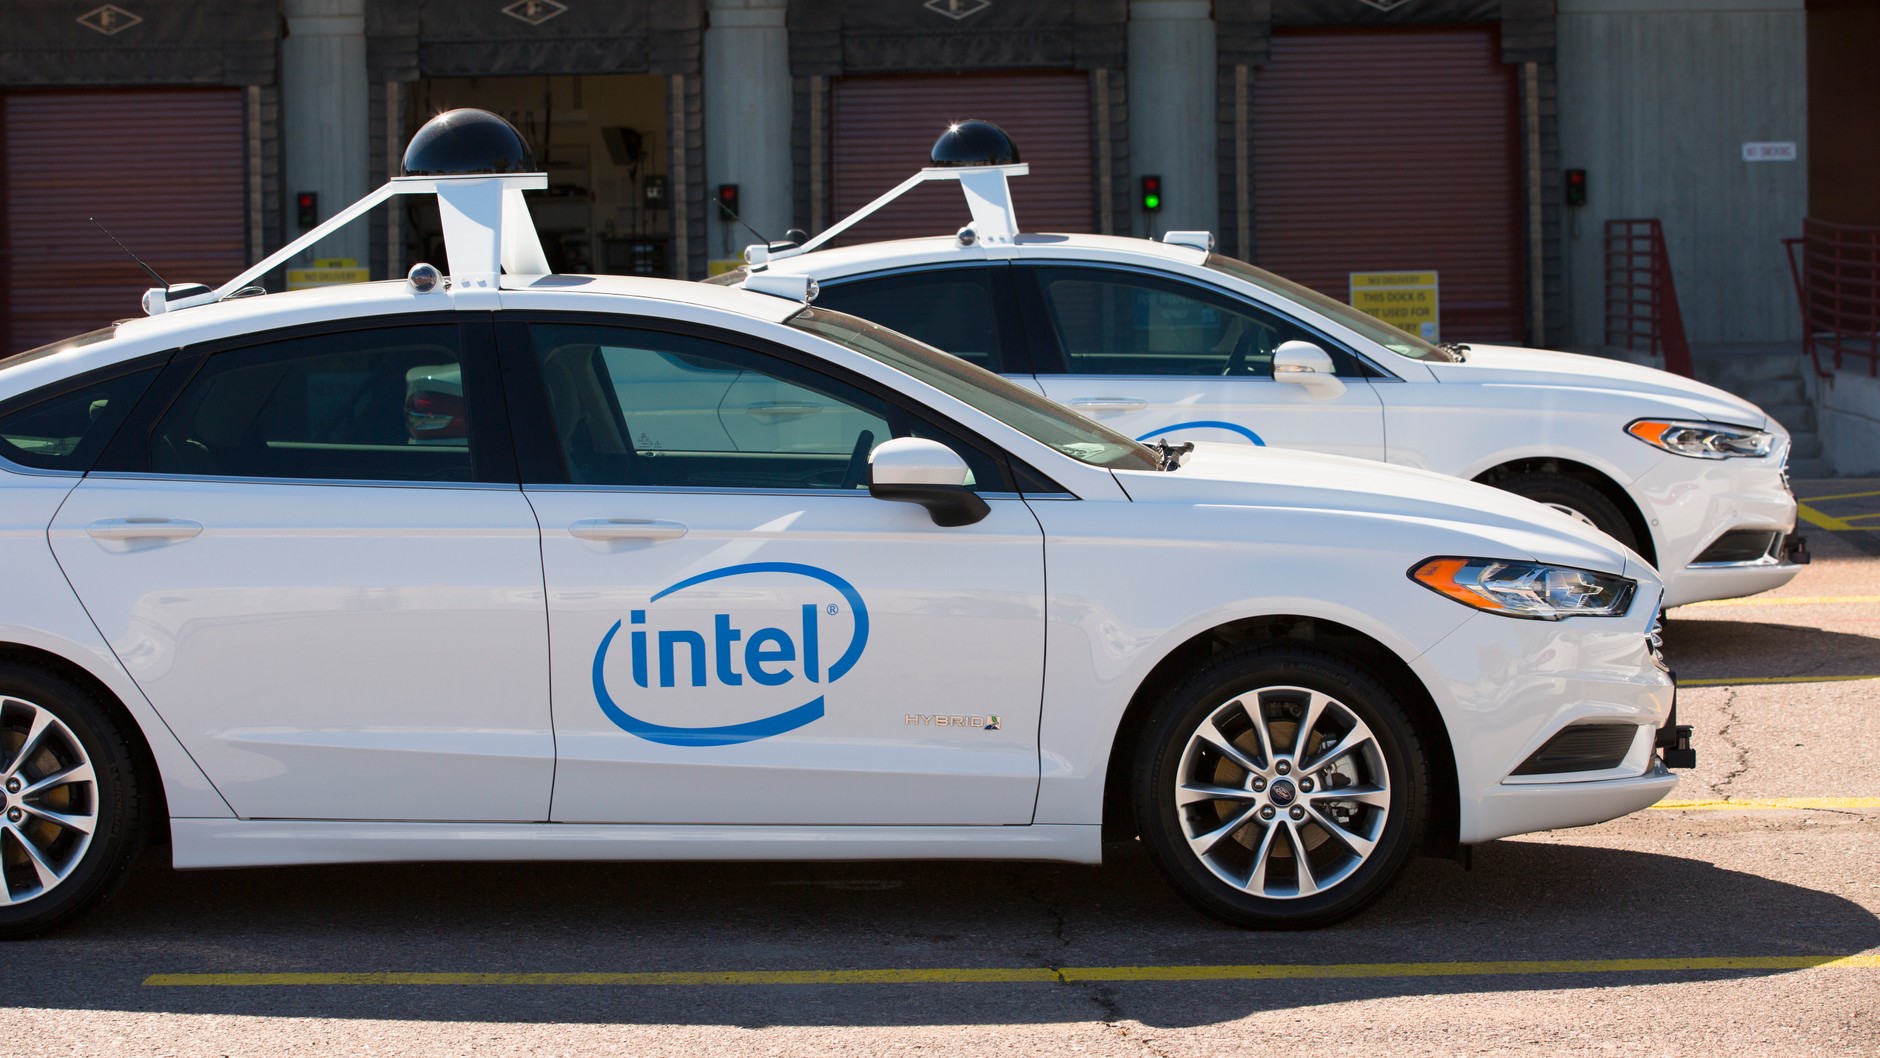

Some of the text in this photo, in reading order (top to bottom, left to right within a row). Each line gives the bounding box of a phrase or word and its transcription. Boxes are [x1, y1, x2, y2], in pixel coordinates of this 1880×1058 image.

[1747, 146, 1757, 157] NO
[304, 272, 357, 280] NO DELIVERY
[1368, 275, 1420, 284] NO DELIVERY
[1363, 291, 1426, 302] THIS DOCK IS
[1382, 307, 1409, 317] USED
[1410, 306, 1430, 316] FOR
[630, 603, 820, 689] intel
[904, 713, 985, 728] HYBRID
